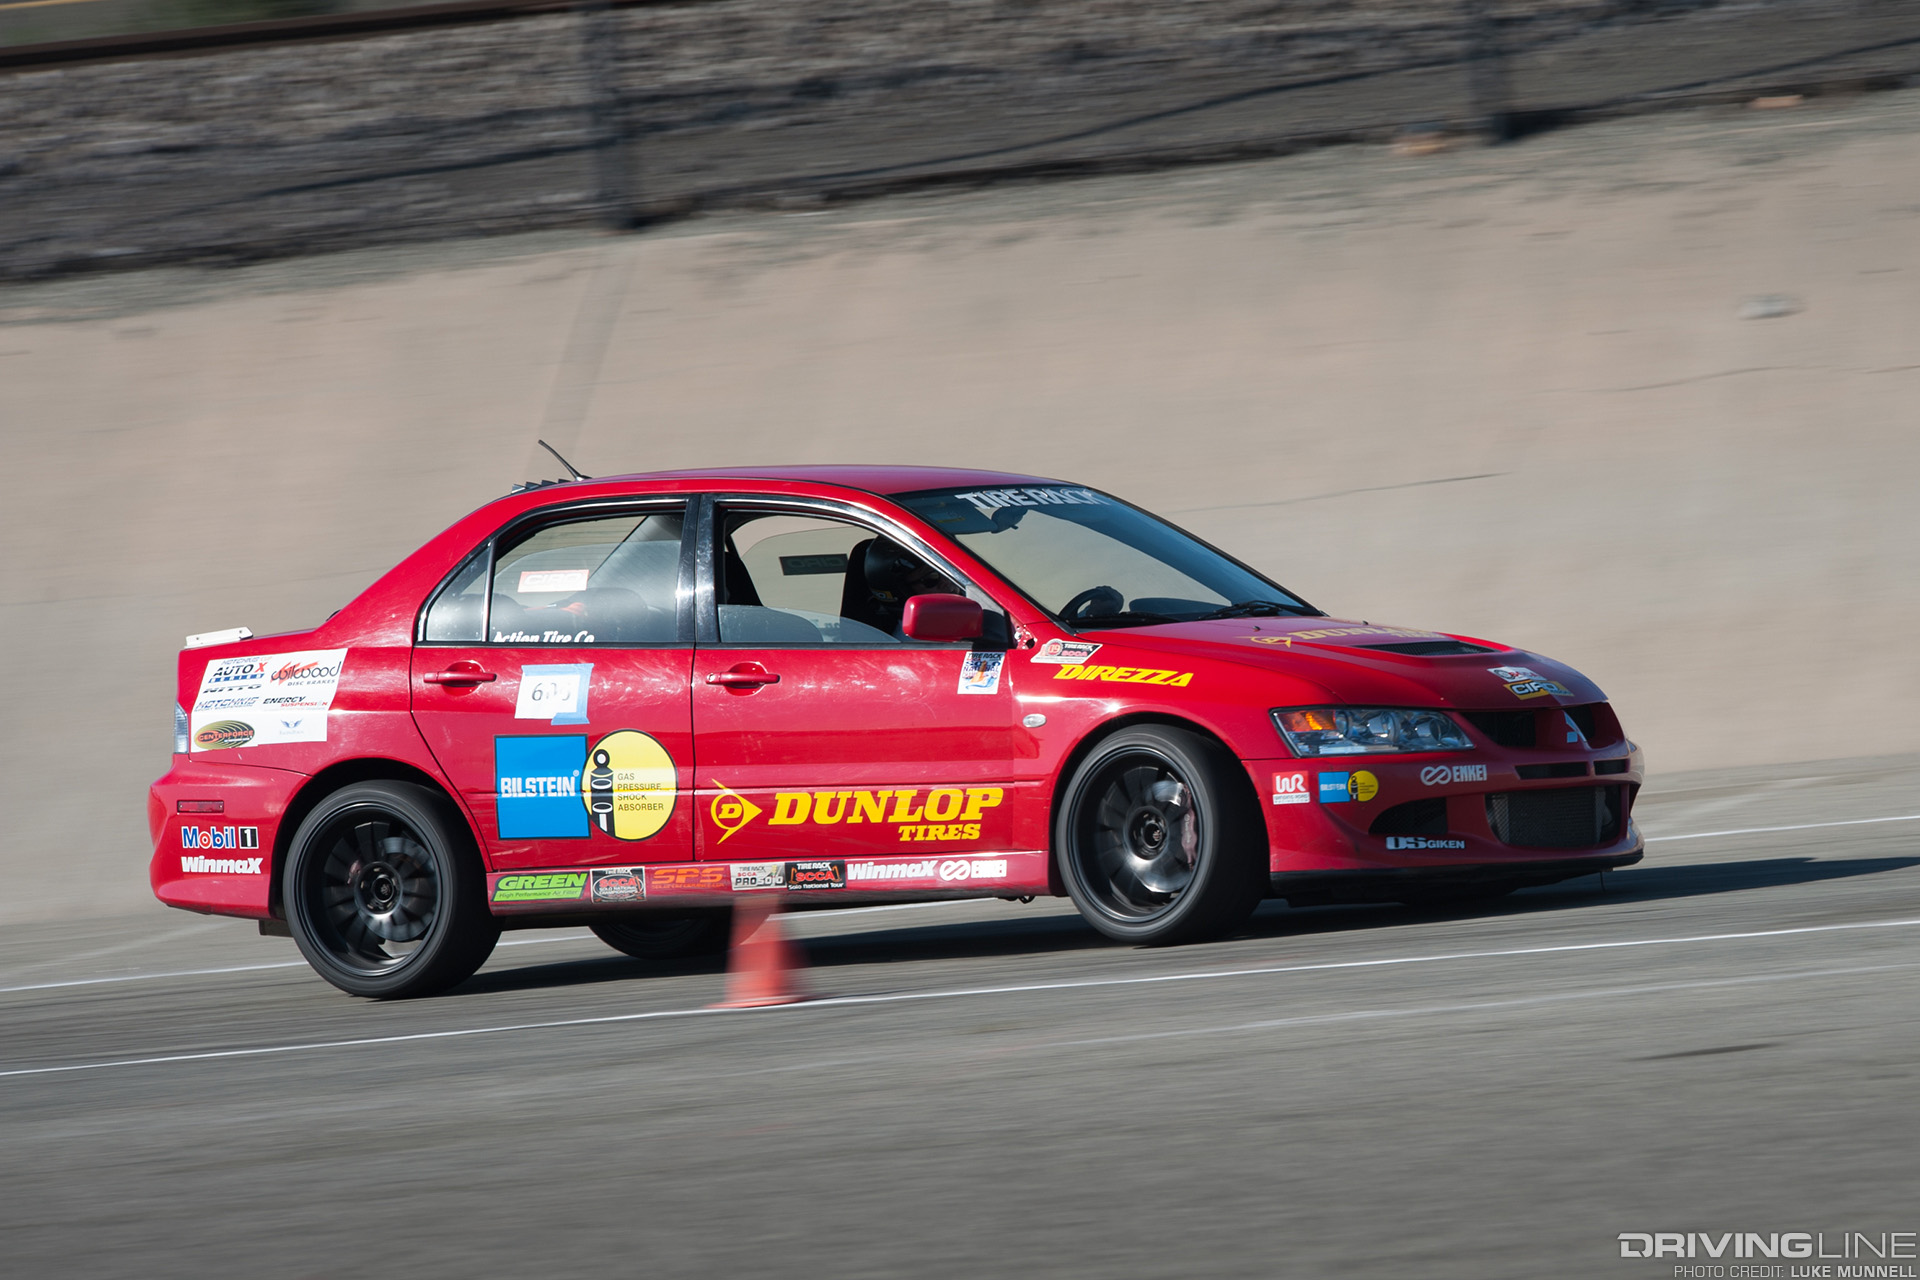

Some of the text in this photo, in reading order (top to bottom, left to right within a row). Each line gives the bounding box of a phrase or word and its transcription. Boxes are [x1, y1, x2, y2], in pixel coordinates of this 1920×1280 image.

[954, 487, 1110, 509] TIRE RACK
[493, 630, 595, 643] Action Tire Co
[213, 662, 268, 677] AUTO X
[1053, 664, 1194, 687] DIREZZA
[263, 696, 306, 705] ENERGY
[199, 730, 253, 740] CENTERFORCE
[617, 773, 635, 781] GAS
[1452, 765, 1487, 783] ENKEI
[500, 776, 576, 798] BILSTEIN
[617, 783, 662, 791] PRESSURE
[617, 793, 647, 801] SHOCK
[618, 803, 664, 811] ABSORBER
[768, 787, 1003, 826] DUNLOP
[181, 826, 236, 849] Mobil
[898, 823, 981, 842] TIRES
[1427, 840, 1465, 849] GIKEN
[498, 873, 588, 890] GREEN
[599, 877, 637, 888] SCCA
[651, 867, 725, 885] SPS
[795, 871, 836, 881] SCCA
